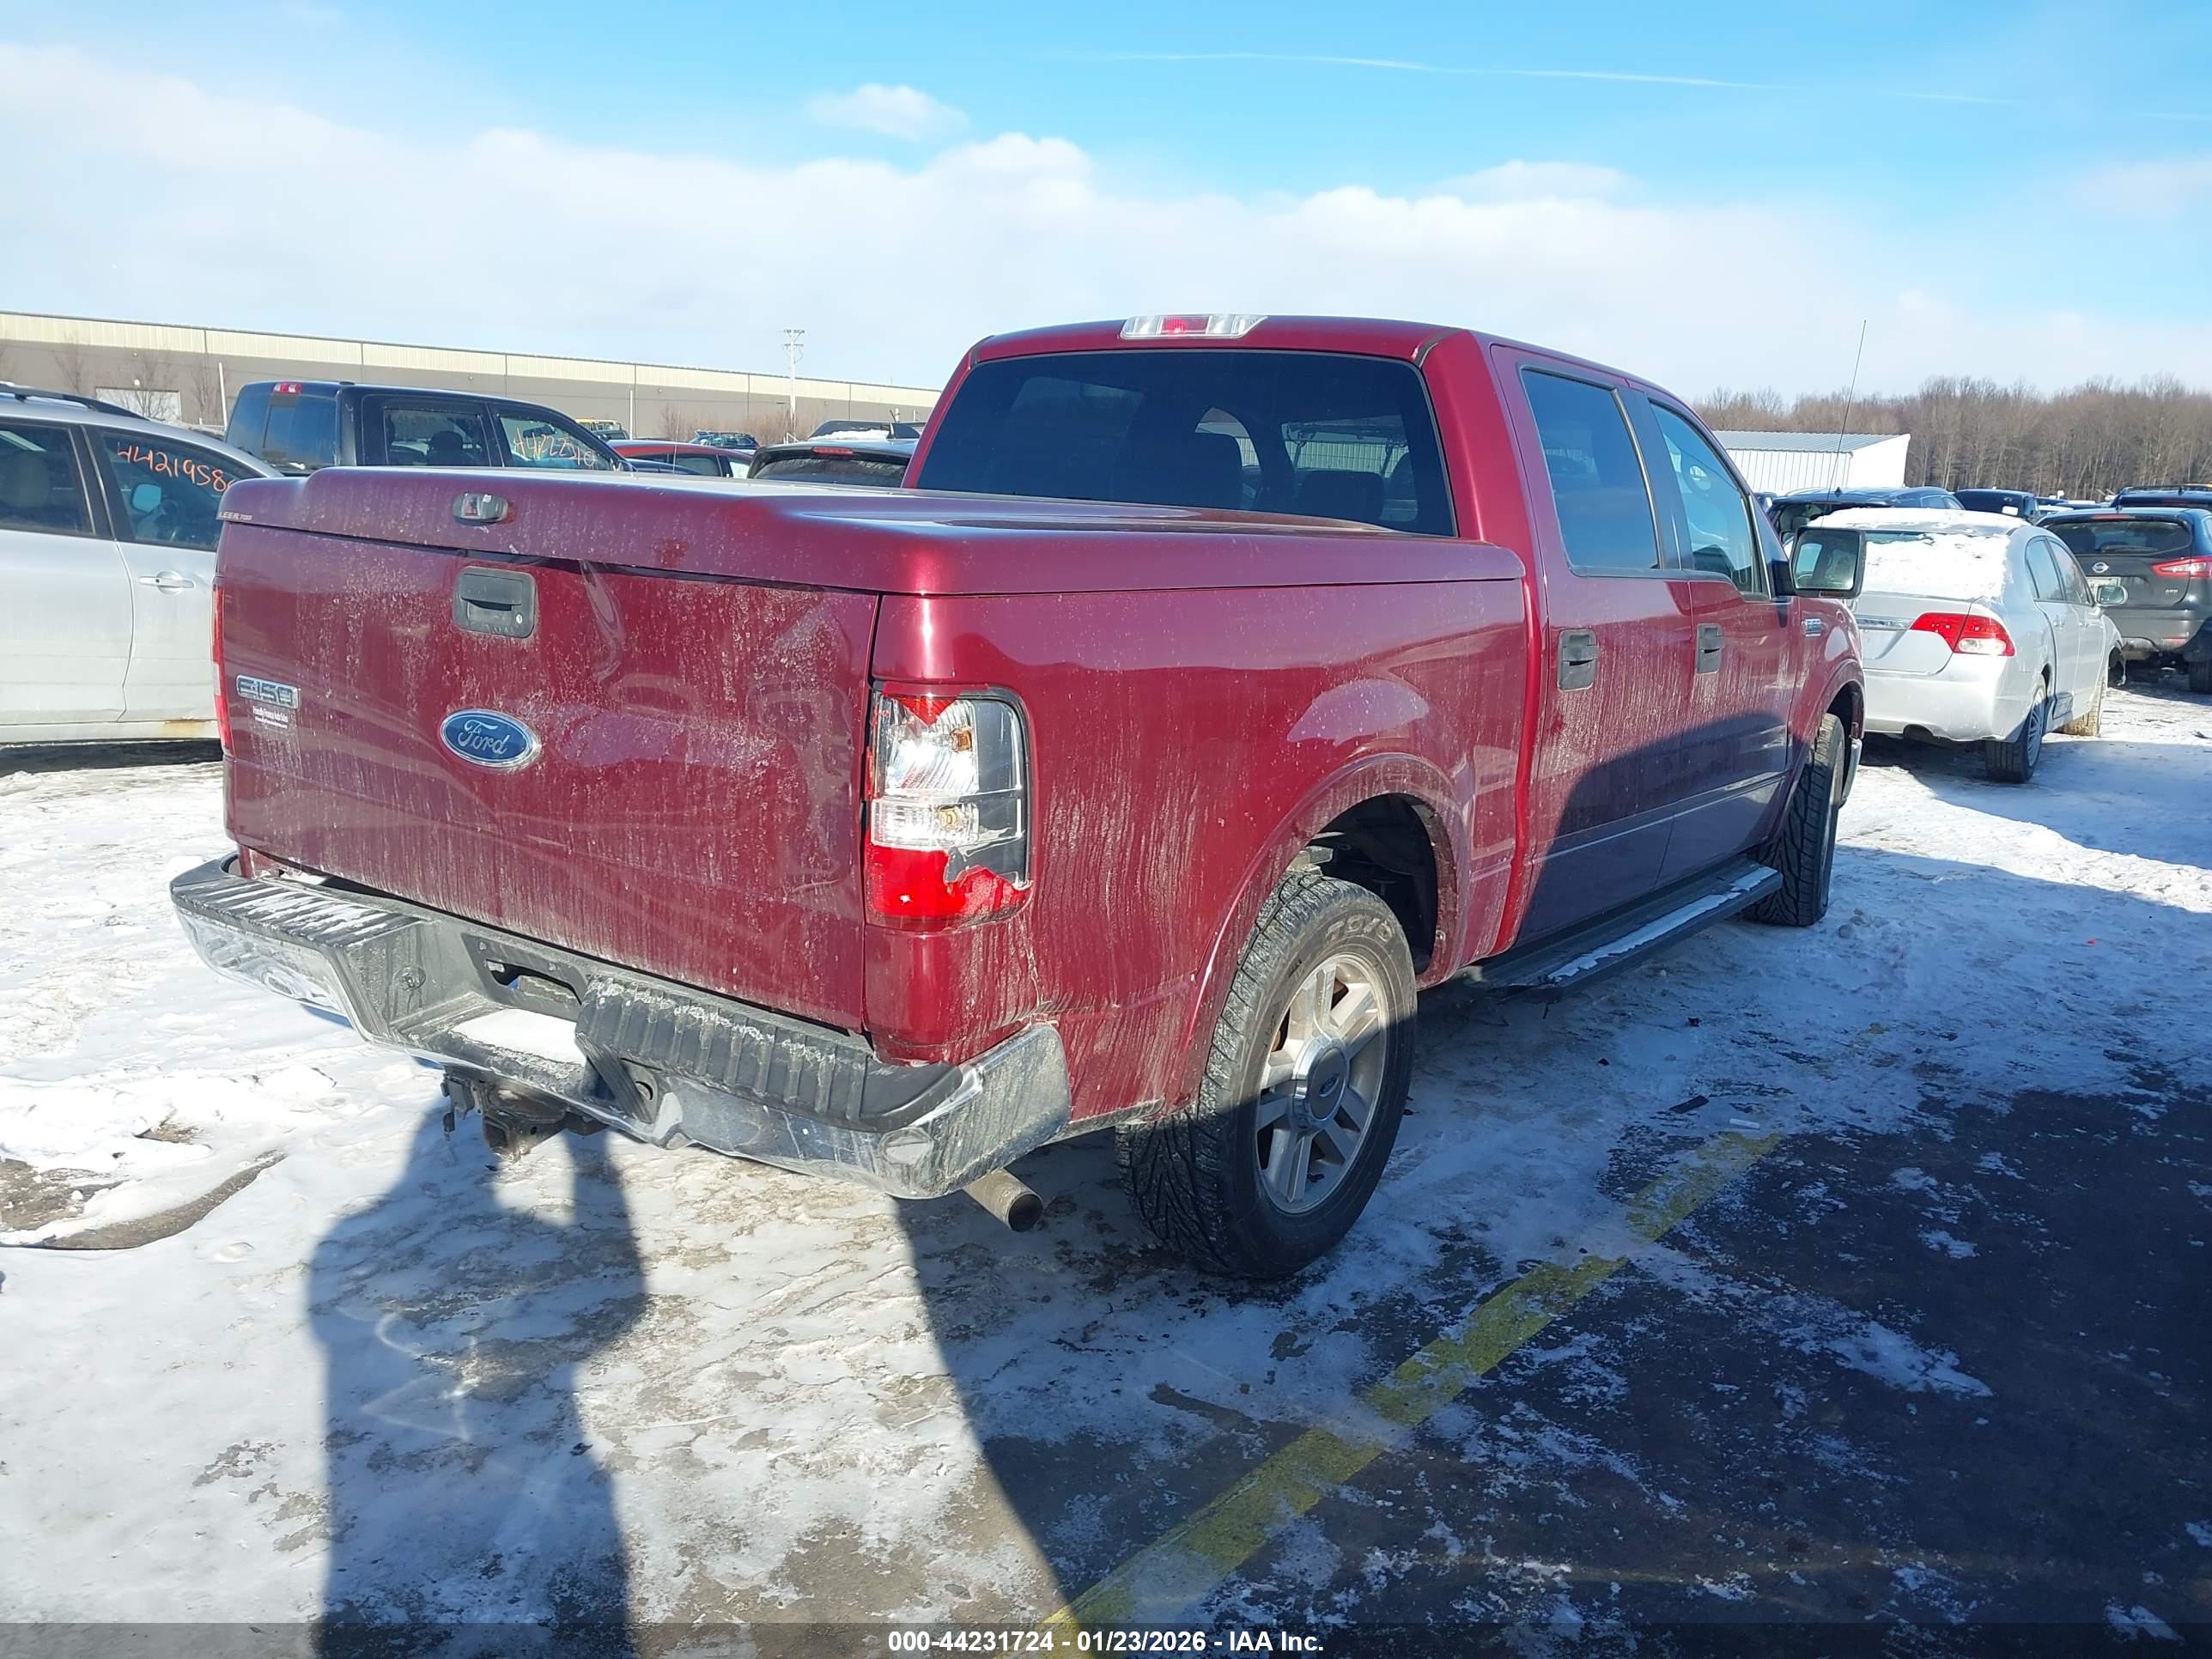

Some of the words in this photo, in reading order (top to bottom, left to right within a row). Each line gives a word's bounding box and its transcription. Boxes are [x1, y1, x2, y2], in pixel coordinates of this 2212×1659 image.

[117, 441, 234, 492] 4421958
[458, 720, 510, 754] Ford
[1325, 914, 1393, 942] TOYO
